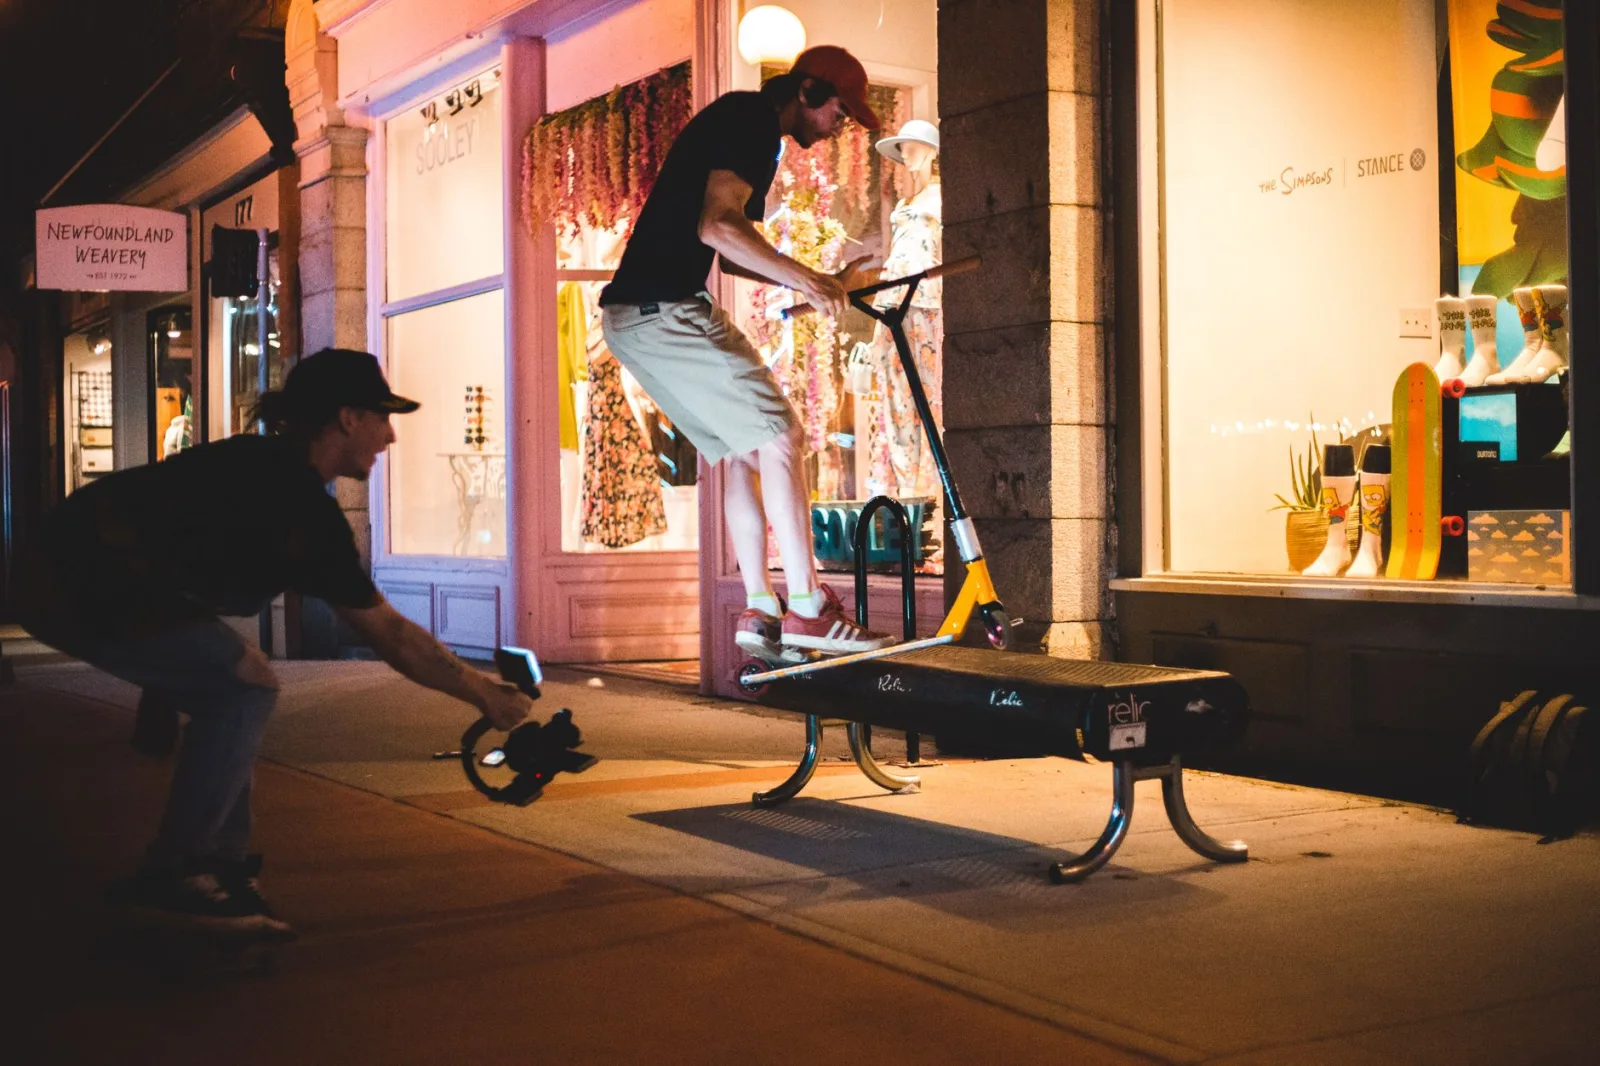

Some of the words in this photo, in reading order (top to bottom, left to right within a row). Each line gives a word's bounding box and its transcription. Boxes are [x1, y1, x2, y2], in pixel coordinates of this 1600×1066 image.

[416, 119, 476, 176] SOOLEY
[1357, 153, 1405, 178] STANCE
[234, 194, 253, 228] 177
[47, 222, 174, 244] NEWFOUNDLAND
[75, 245, 148, 270] WEAVERY
[1107, 692, 1152, 724] relic
